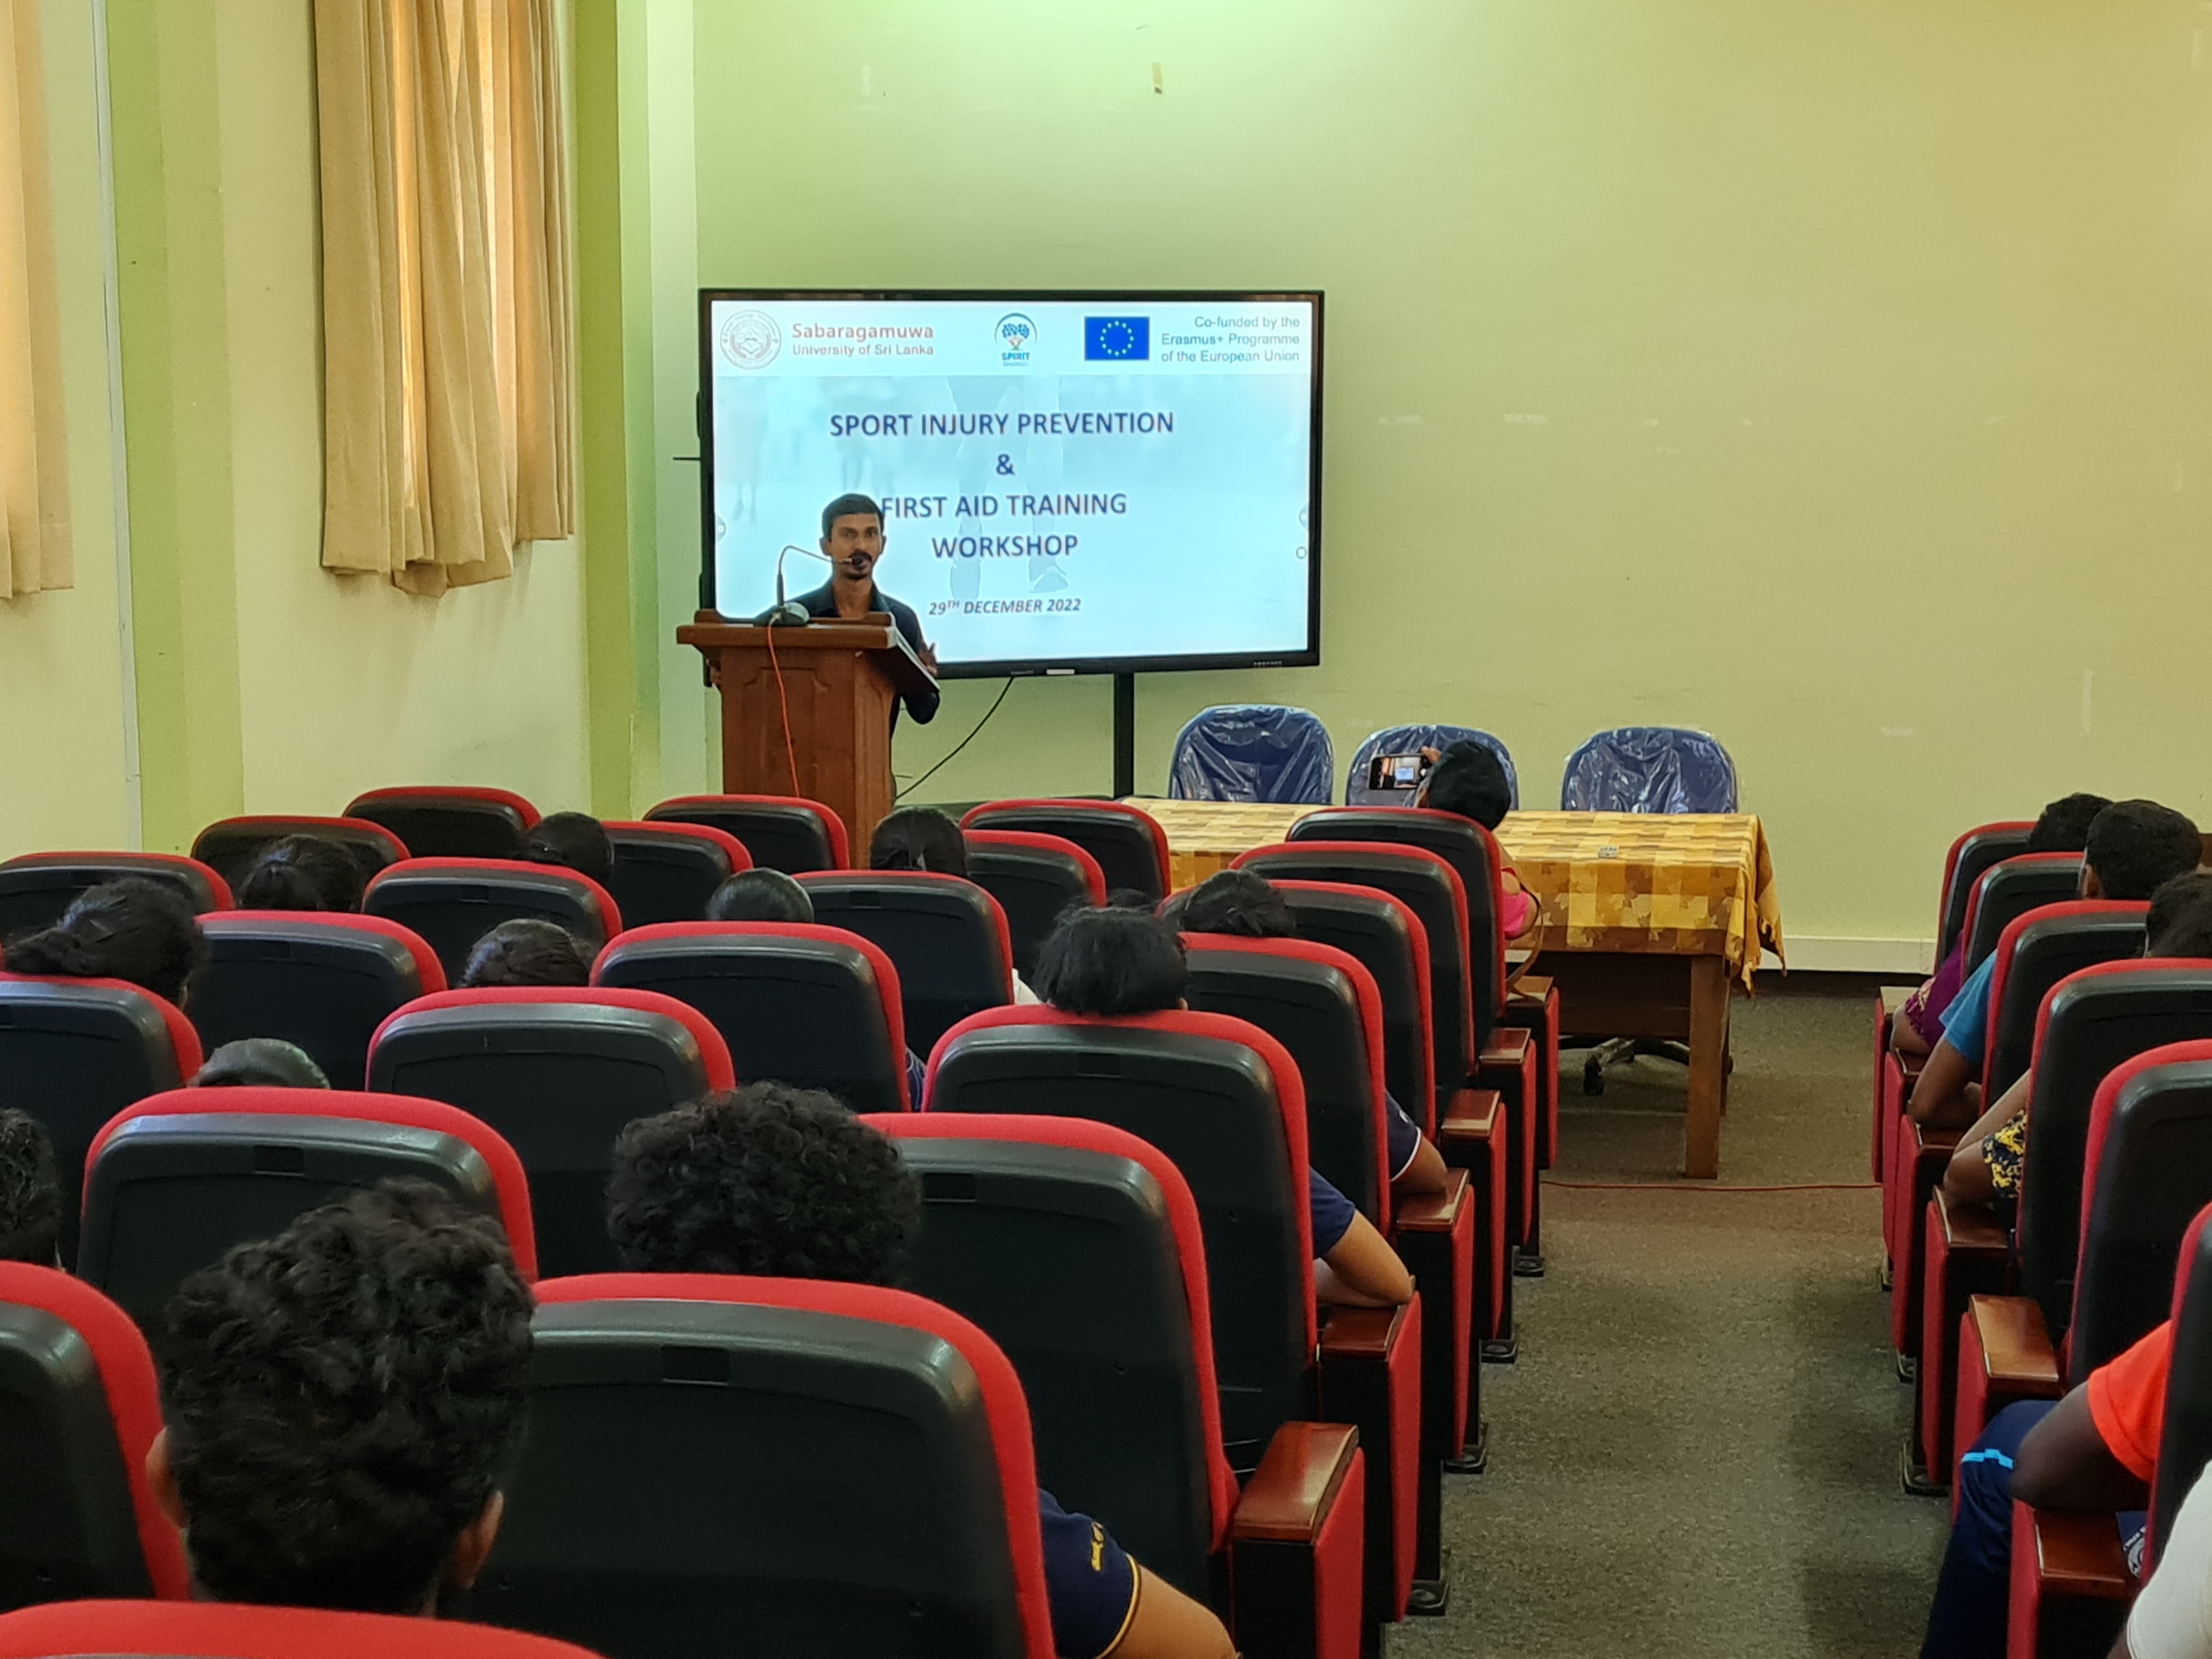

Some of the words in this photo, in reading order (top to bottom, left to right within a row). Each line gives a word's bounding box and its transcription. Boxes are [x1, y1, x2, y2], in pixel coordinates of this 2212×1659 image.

[1194, 315, 1259, 328] Co-funded
[1263, 316, 1277, 330] by
[1281, 317, 1300, 328] the
[792, 323, 934, 342] Sabaragamuwa
[1161, 332, 1223, 345] Erasmus+
[1228, 333, 1300, 347] Programme
[792, 345, 854, 357] University
[859, 345, 871, 355] of
[874, 345, 891, 355] Sri
[896, 345, 934, 356] Lanka
[1161, 351, 1173, 362] of
[1177, 351, 1197, 362] the
[1200, 350, 1260, 364] European
[1265, 350, 1299, 361] Union
[830, 414, 913, 437] SPORT
[921, 413, 1009, 435] INJURY
[1018, 411, 1174, 434] PREVENTION
[996, 453, 1015, 476] &
[882, 496, 947, 518] FIRST
[955, 495, 998, 517] AID
[1006, 493, 1127, 516] TRAINING
[932, 534, 1078, 558] WORKSHOP
[963, 599, 1042, 614] DECEMBER
[1046, 598, 1081, 611] 2022
